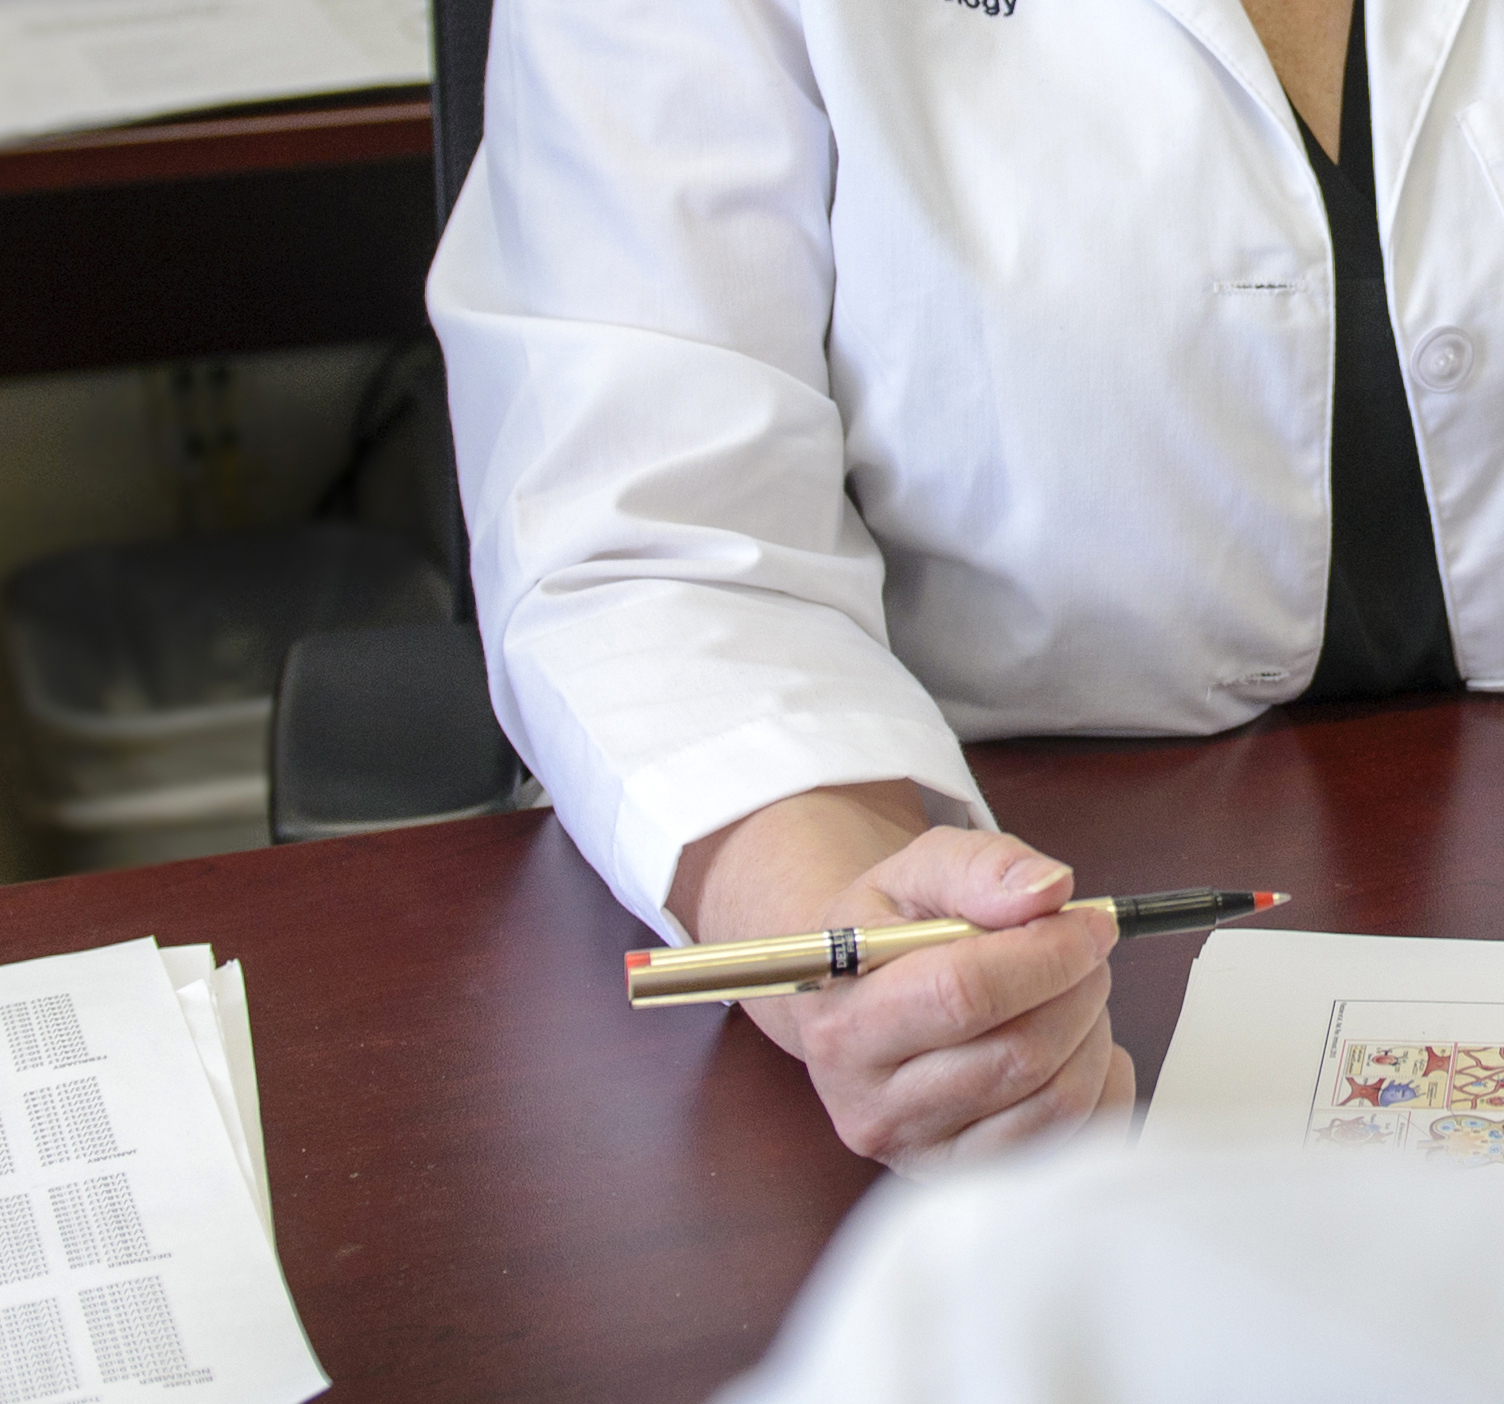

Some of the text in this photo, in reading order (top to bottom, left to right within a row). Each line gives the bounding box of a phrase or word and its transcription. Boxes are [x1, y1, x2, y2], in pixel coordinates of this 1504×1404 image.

[53, 1055, 107, 1070] FEBRUARY
[87, 1149, 136, 1164] JANUARY
[108, 1253, 172, 1268] DECEMBER
[140, 1368, 210, 1385] NOVEMBER
[163, 1376, 213, 1389] Bill Date
